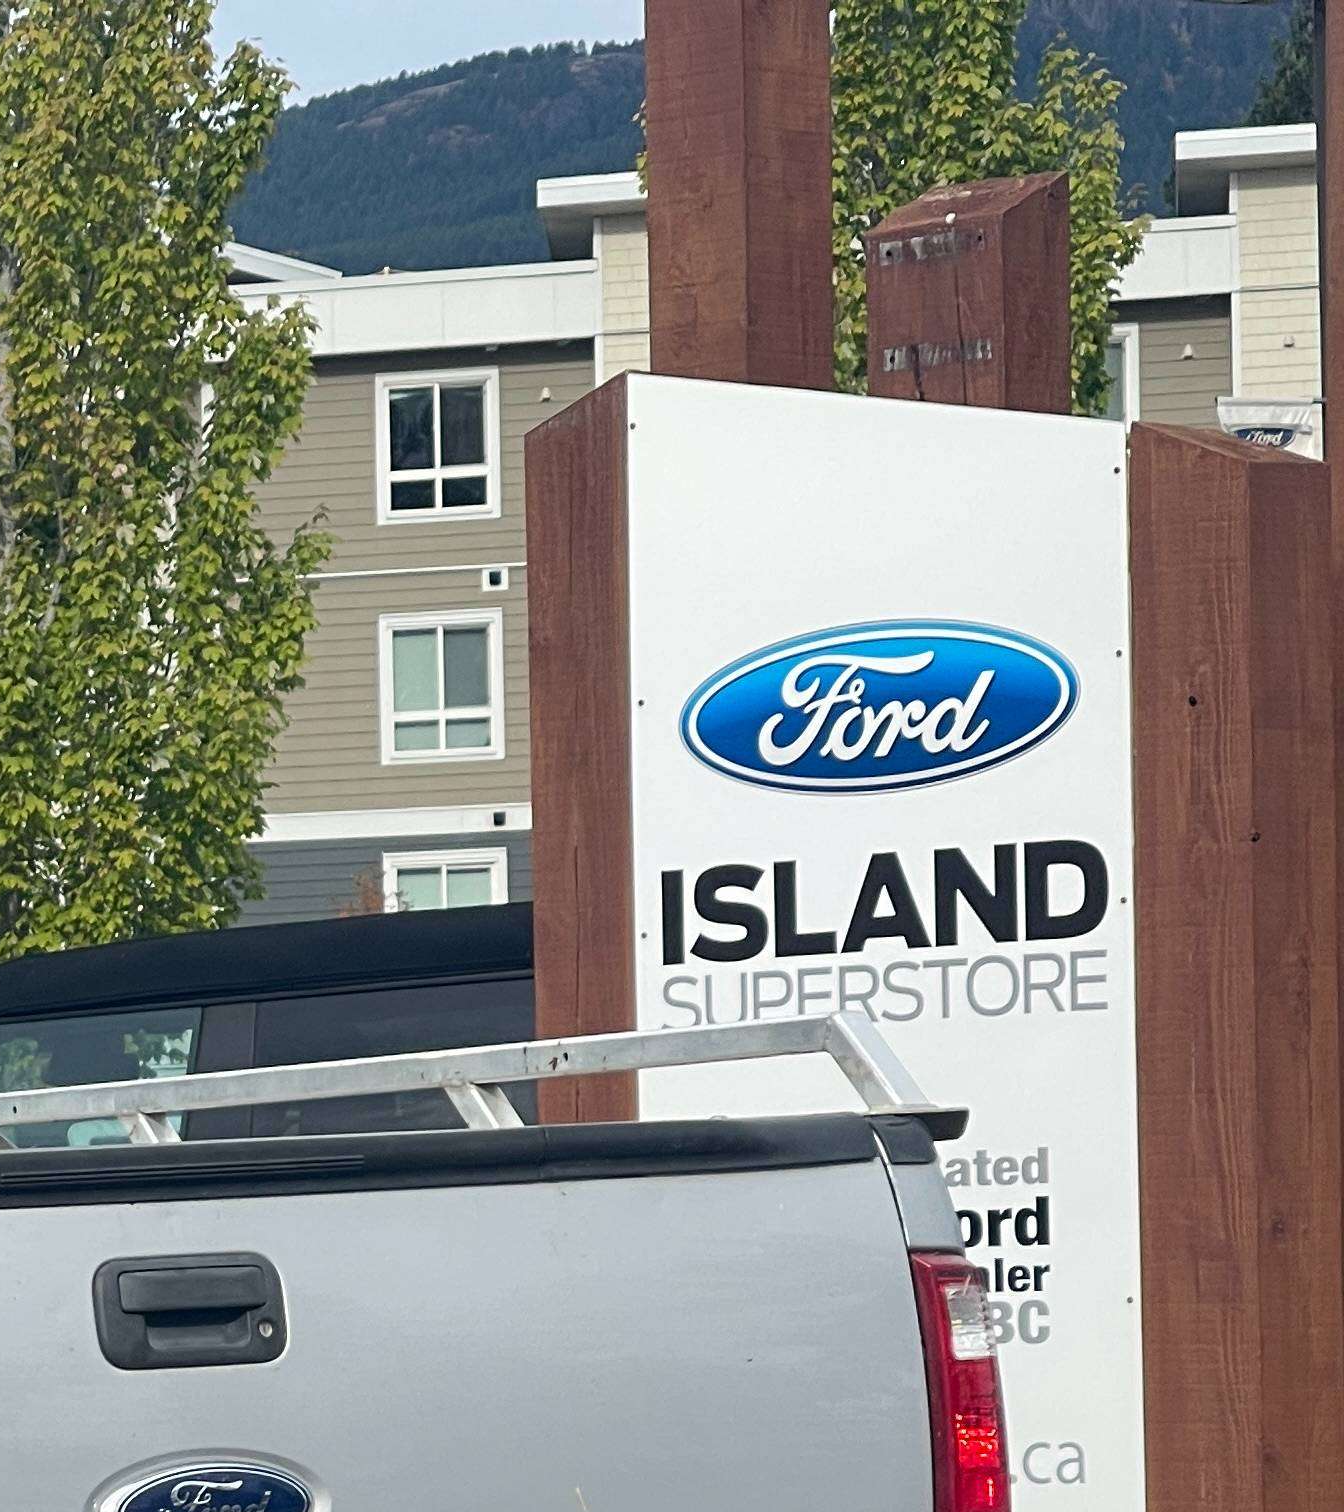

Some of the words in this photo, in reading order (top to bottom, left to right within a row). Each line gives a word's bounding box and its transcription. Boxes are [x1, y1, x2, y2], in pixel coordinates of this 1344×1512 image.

[758, 649, 996, 766] Ford
[661, 839, 1109, 966] ISLAND
[662, 949, 1109, 1030] SUPERSTORE
[944, 1147, 1049, 1188] ated
[955, 1195, 1050, 1248] ord
[980, 1257, 1050, 1293] ler
[1010, 1441, 1086, 1485] .ca
